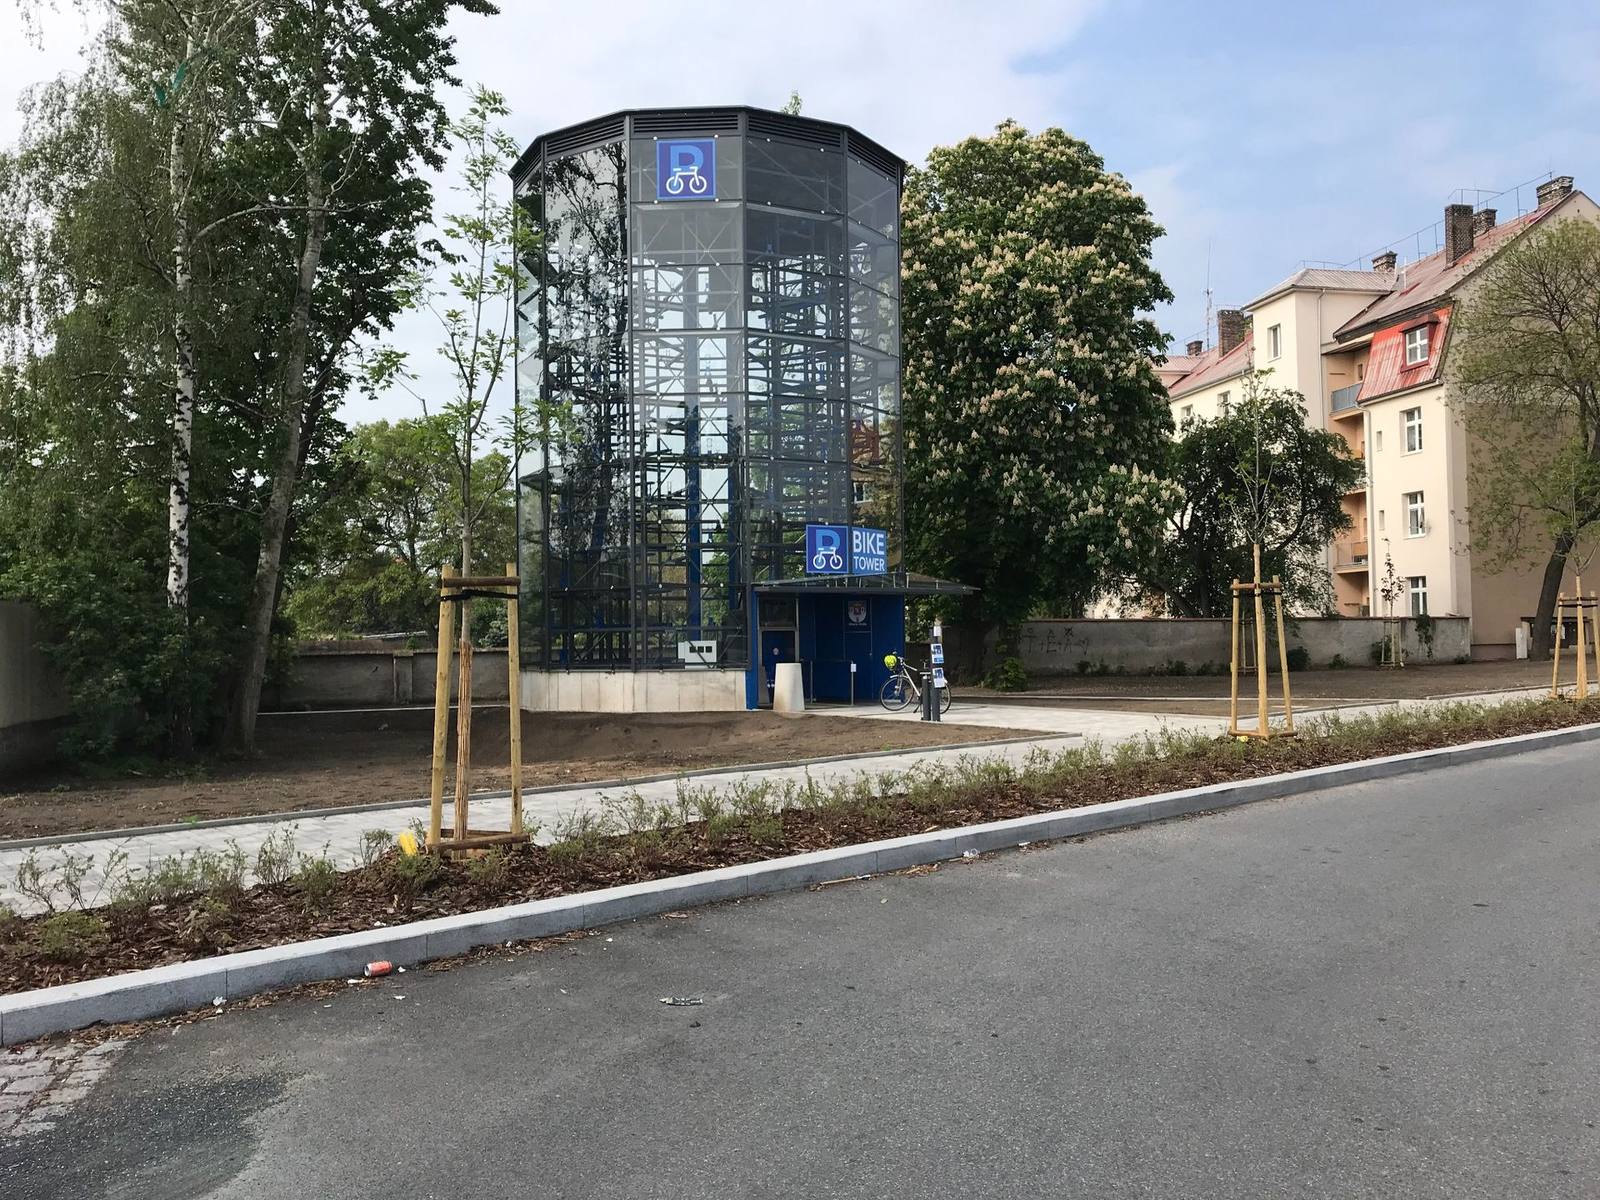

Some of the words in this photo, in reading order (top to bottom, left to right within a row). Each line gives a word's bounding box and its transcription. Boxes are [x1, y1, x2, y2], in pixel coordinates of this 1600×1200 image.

[670, 145, 704, 191] P
[815, 529, 841, 566] P
[853, 530, 885, 555] BIKE
[853, 556, 885, 572] TOWER
